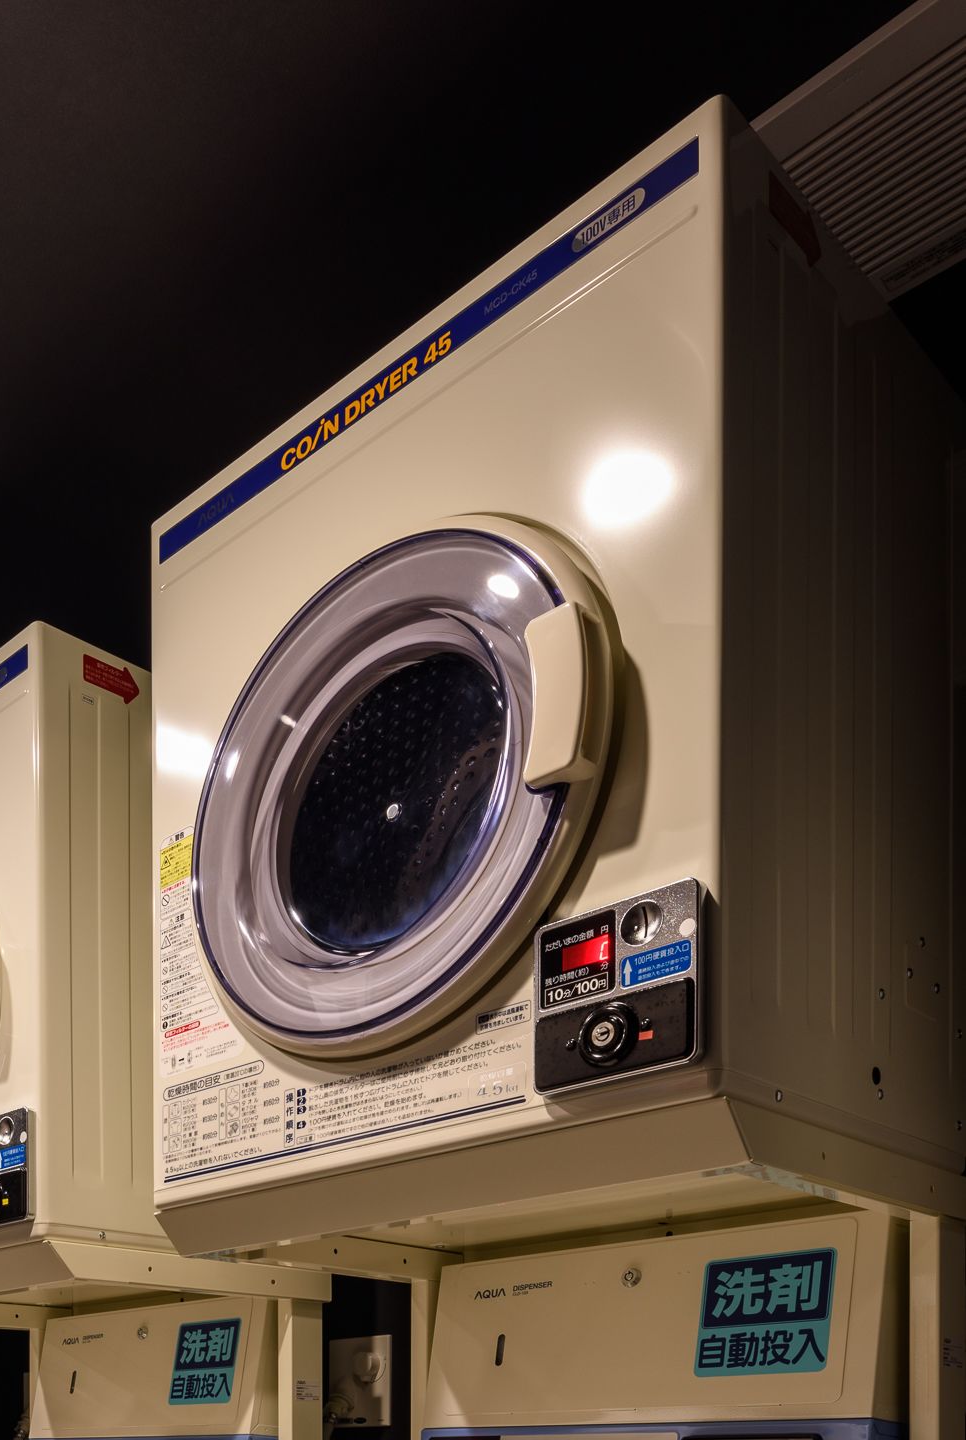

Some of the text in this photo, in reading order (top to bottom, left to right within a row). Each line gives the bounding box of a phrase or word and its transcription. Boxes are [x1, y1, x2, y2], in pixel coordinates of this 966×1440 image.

[581, 195, 636, 244] 100V専用
[343, 356, 419, 429] DRYER
[423, 331, 453, 367] 45
[197, 492, 234, 529] AQUA
[545, 930, 594, 953] ただいまの金額
[600, 924, 609, 935] 円
[600, 961, 609, 971] 分
[634, 943, 690, 966] 100円硬貨投入口
[547, 978, 607, 1003] 10分/100円
[167, 1075, 221, 1099] 乾燥時間の目安
[475, 1281, 554, 1300] AQUA DISPENSER
[713, 1259, 823, 1318] 洗剤
[62, 1338, 80, 1346] AQUA
[179, 1327, 233, 1364] 洗剤
[698, 1328, 826, 1369] 自動投入
[171, 1373, 231, 1399] 自動投入
